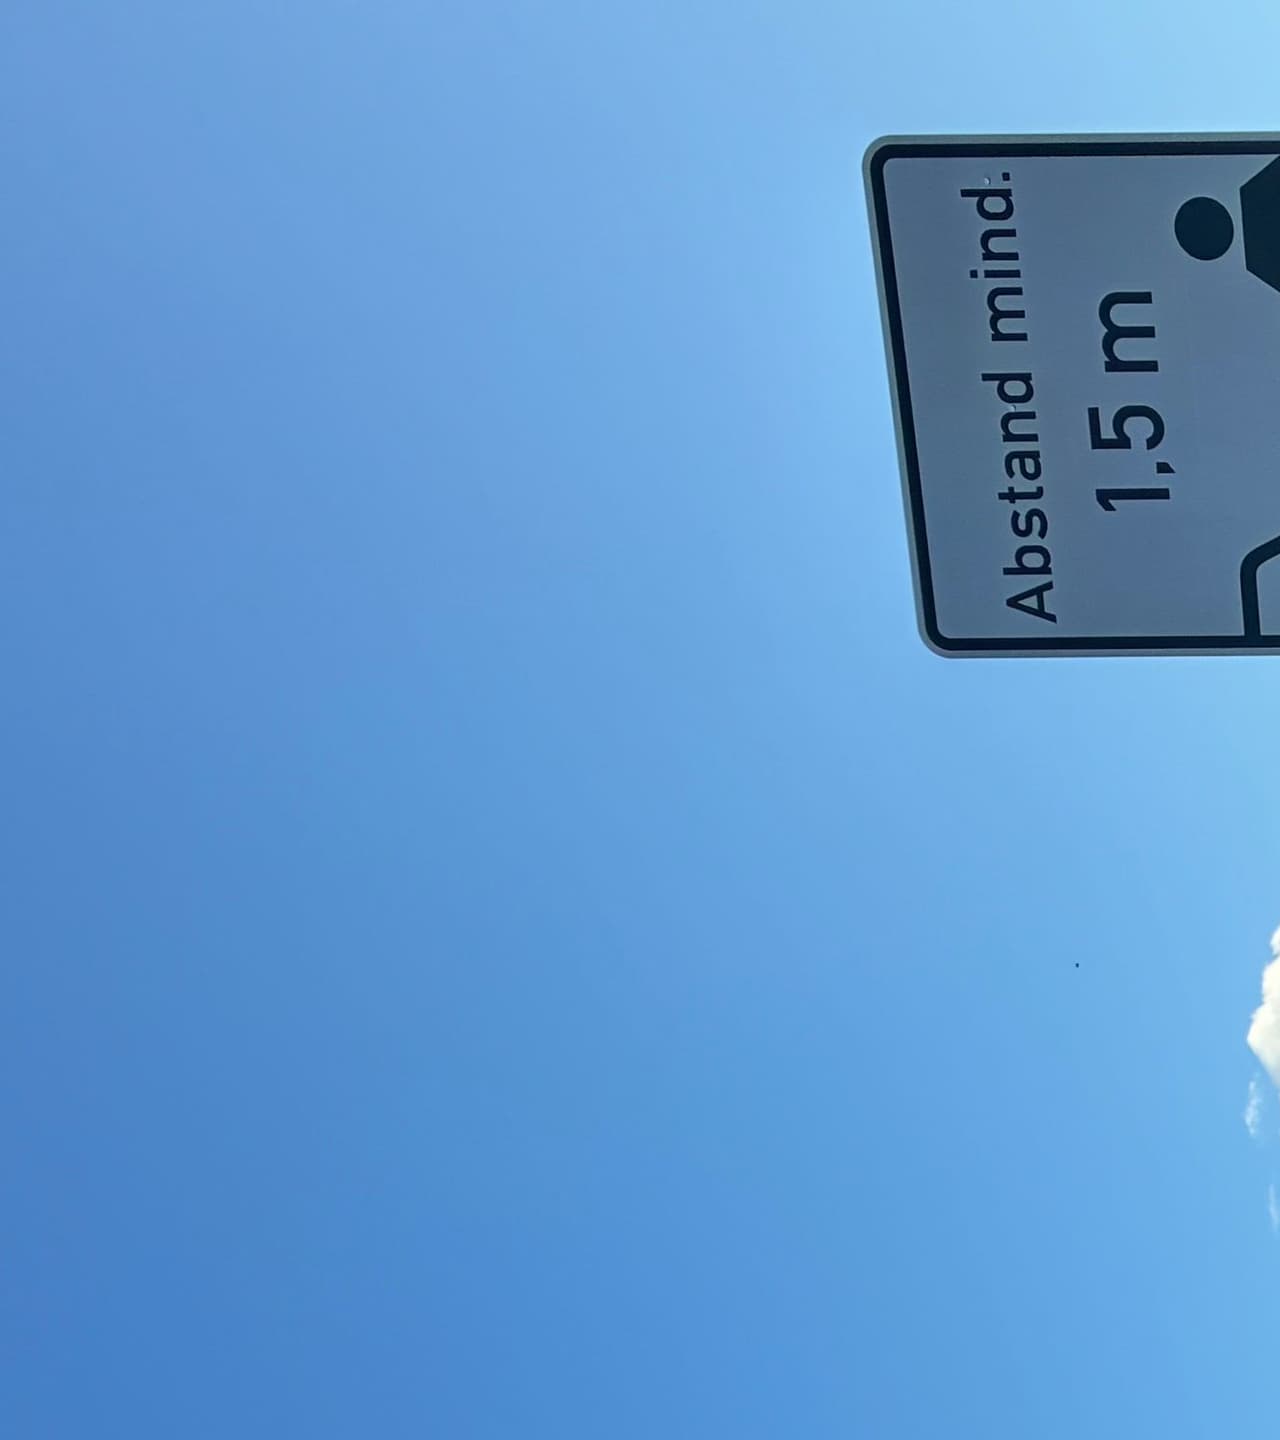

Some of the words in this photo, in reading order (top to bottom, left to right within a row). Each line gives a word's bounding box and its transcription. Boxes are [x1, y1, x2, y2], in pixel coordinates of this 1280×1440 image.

[959, 171, 1029, 342] mind.
[1098, 291, 1159, 373] m
[981, 372, 1058, 624] Abstand
[1087, 405, 1176, 512] 1,5
